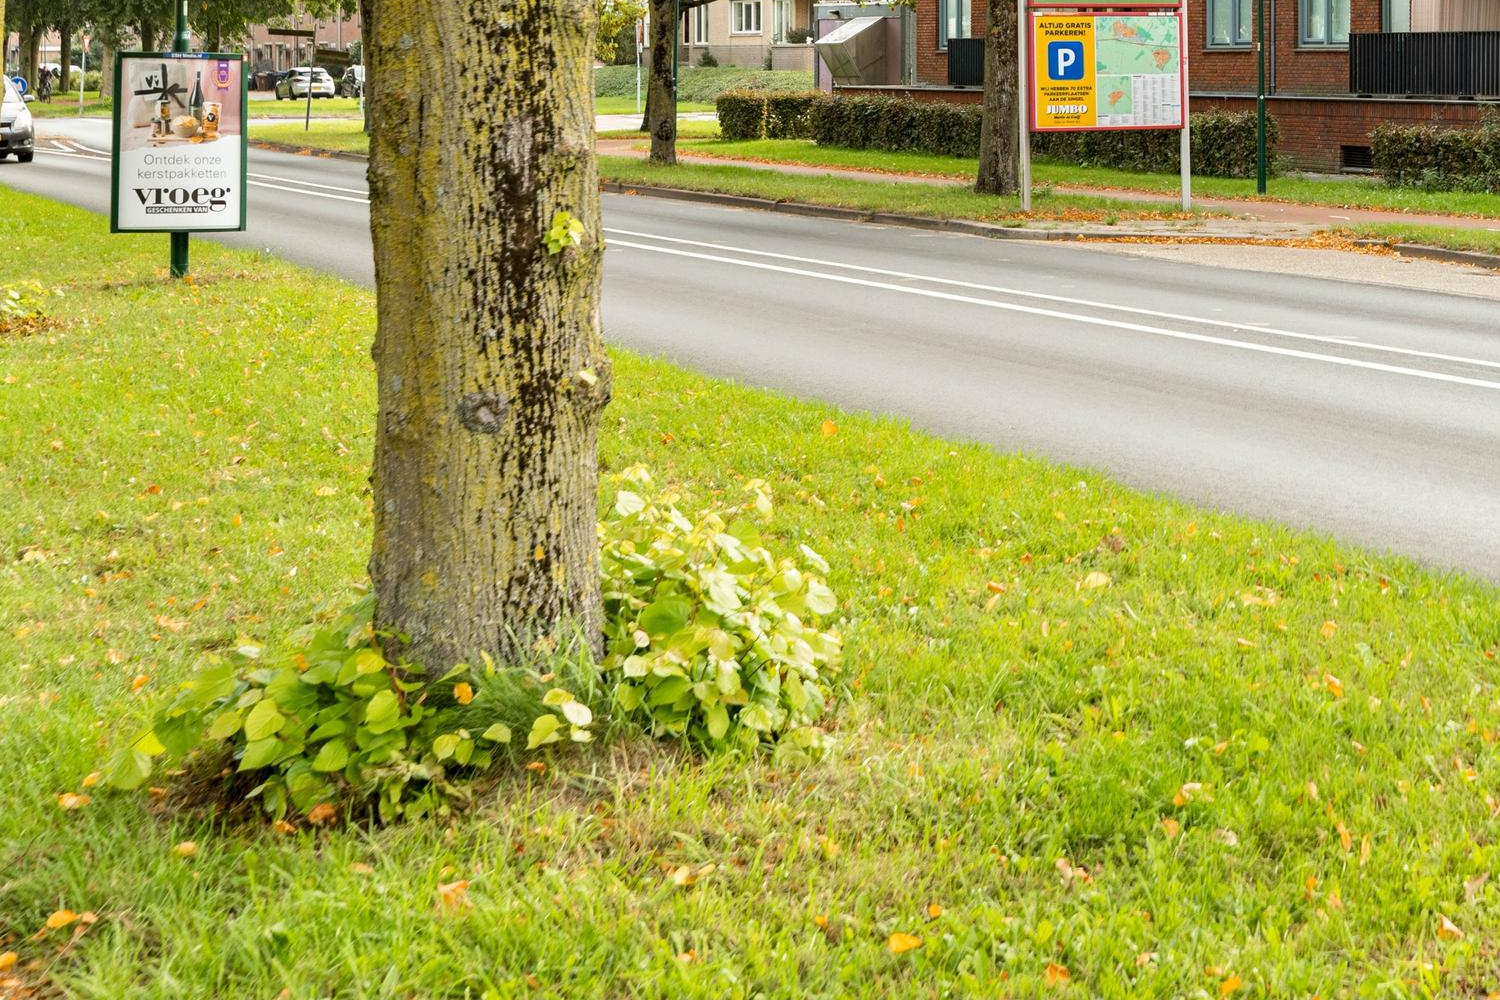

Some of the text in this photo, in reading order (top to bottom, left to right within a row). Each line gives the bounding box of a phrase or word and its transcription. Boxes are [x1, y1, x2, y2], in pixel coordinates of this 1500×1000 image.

[1057, 48, 1076, 76] P
[1046, 104, 1088, 115] JUMBO
[143, 153, 222, 165] Ontdek onze
[137, 168, 227, 180] kerstpakketten
[132, 187, 231, 212] vroeg
[147, 206, 192, 214] GESCHENKEN
